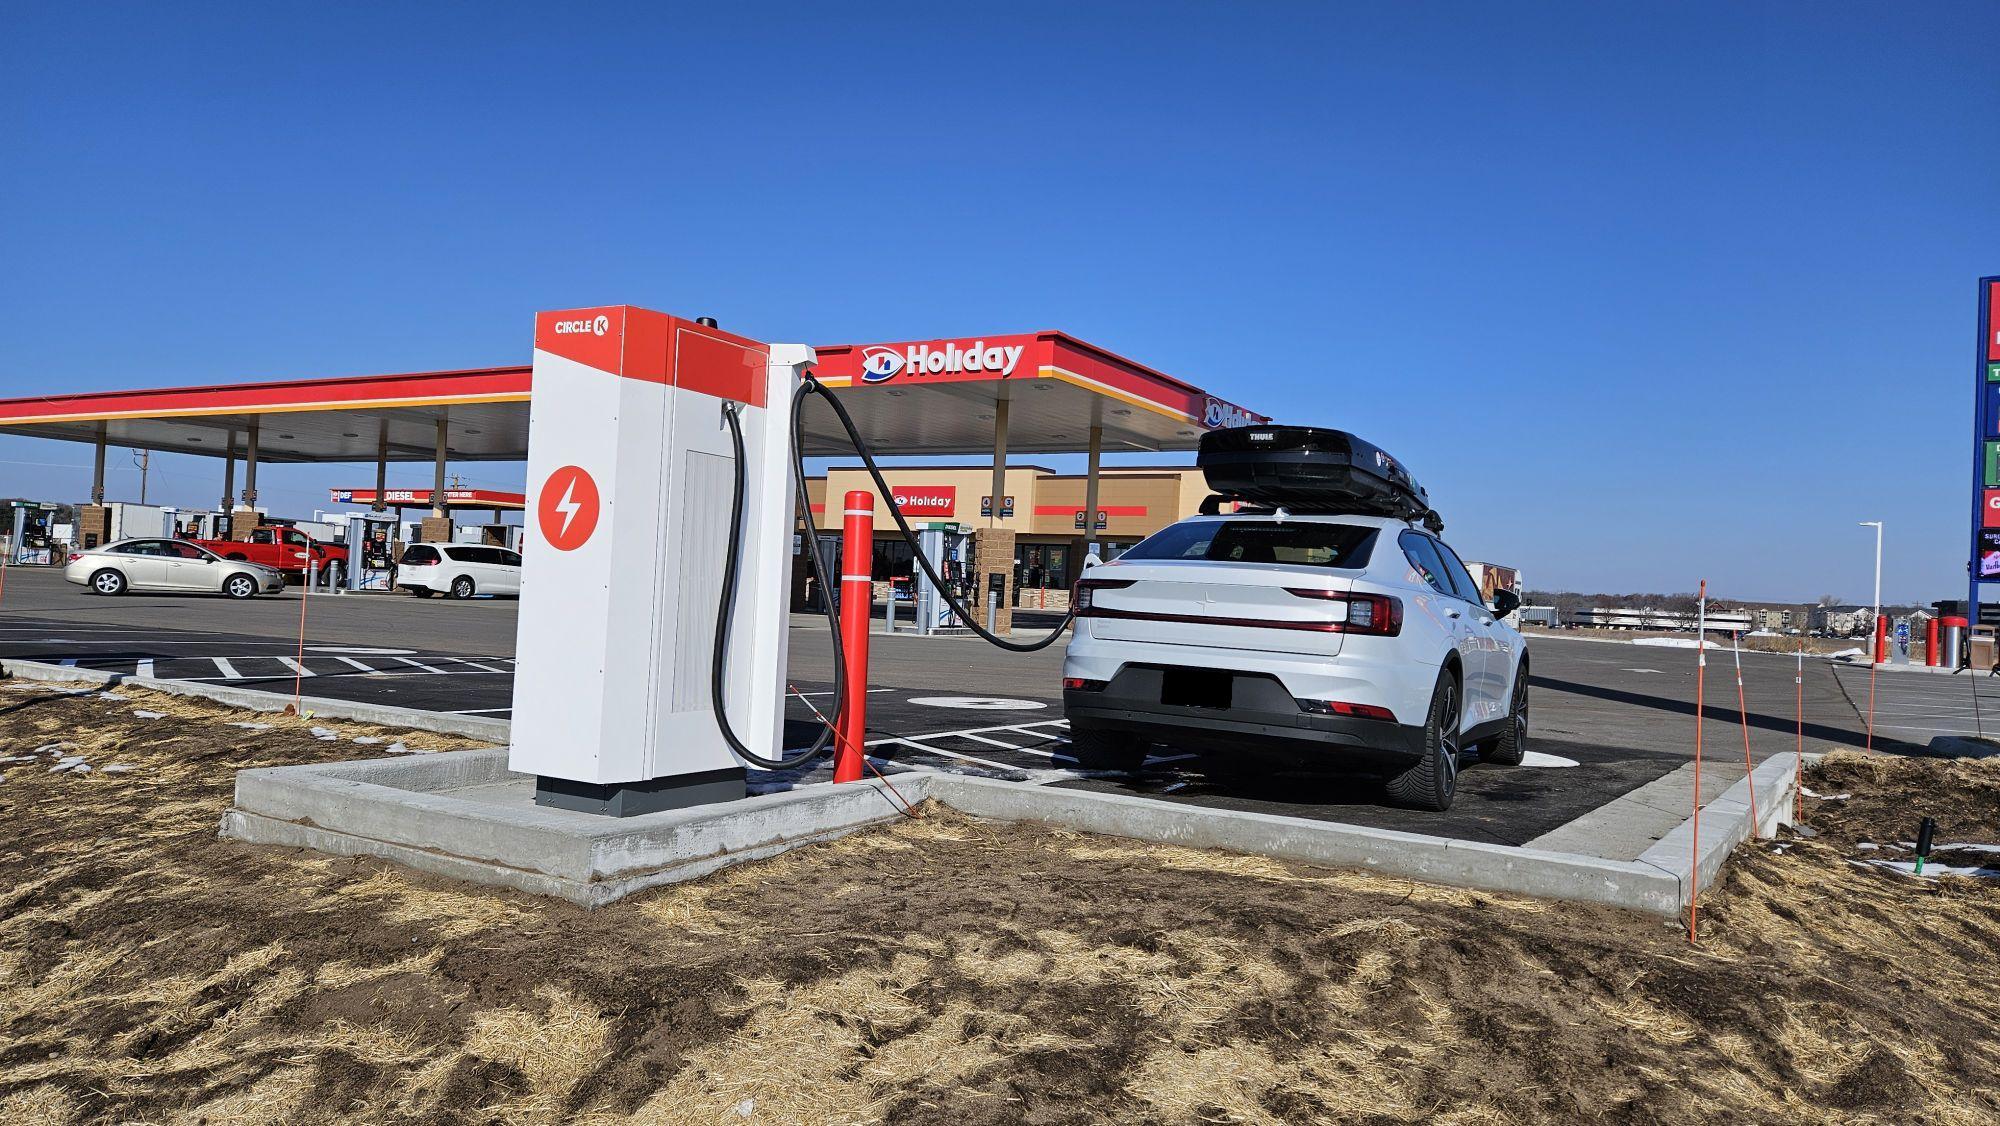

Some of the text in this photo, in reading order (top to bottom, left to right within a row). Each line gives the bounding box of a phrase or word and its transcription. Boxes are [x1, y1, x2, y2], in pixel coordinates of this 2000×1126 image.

[555, 320, 591, 334] CIRCLE
[906, 341, 1024, 376] Holiday
[1249, 433, 1273, 441] THULE
[340, 491, 352, 499] DEF
[386, 491, 415, 500] DIESEL
[910, 495, 952, 509] Holiday
